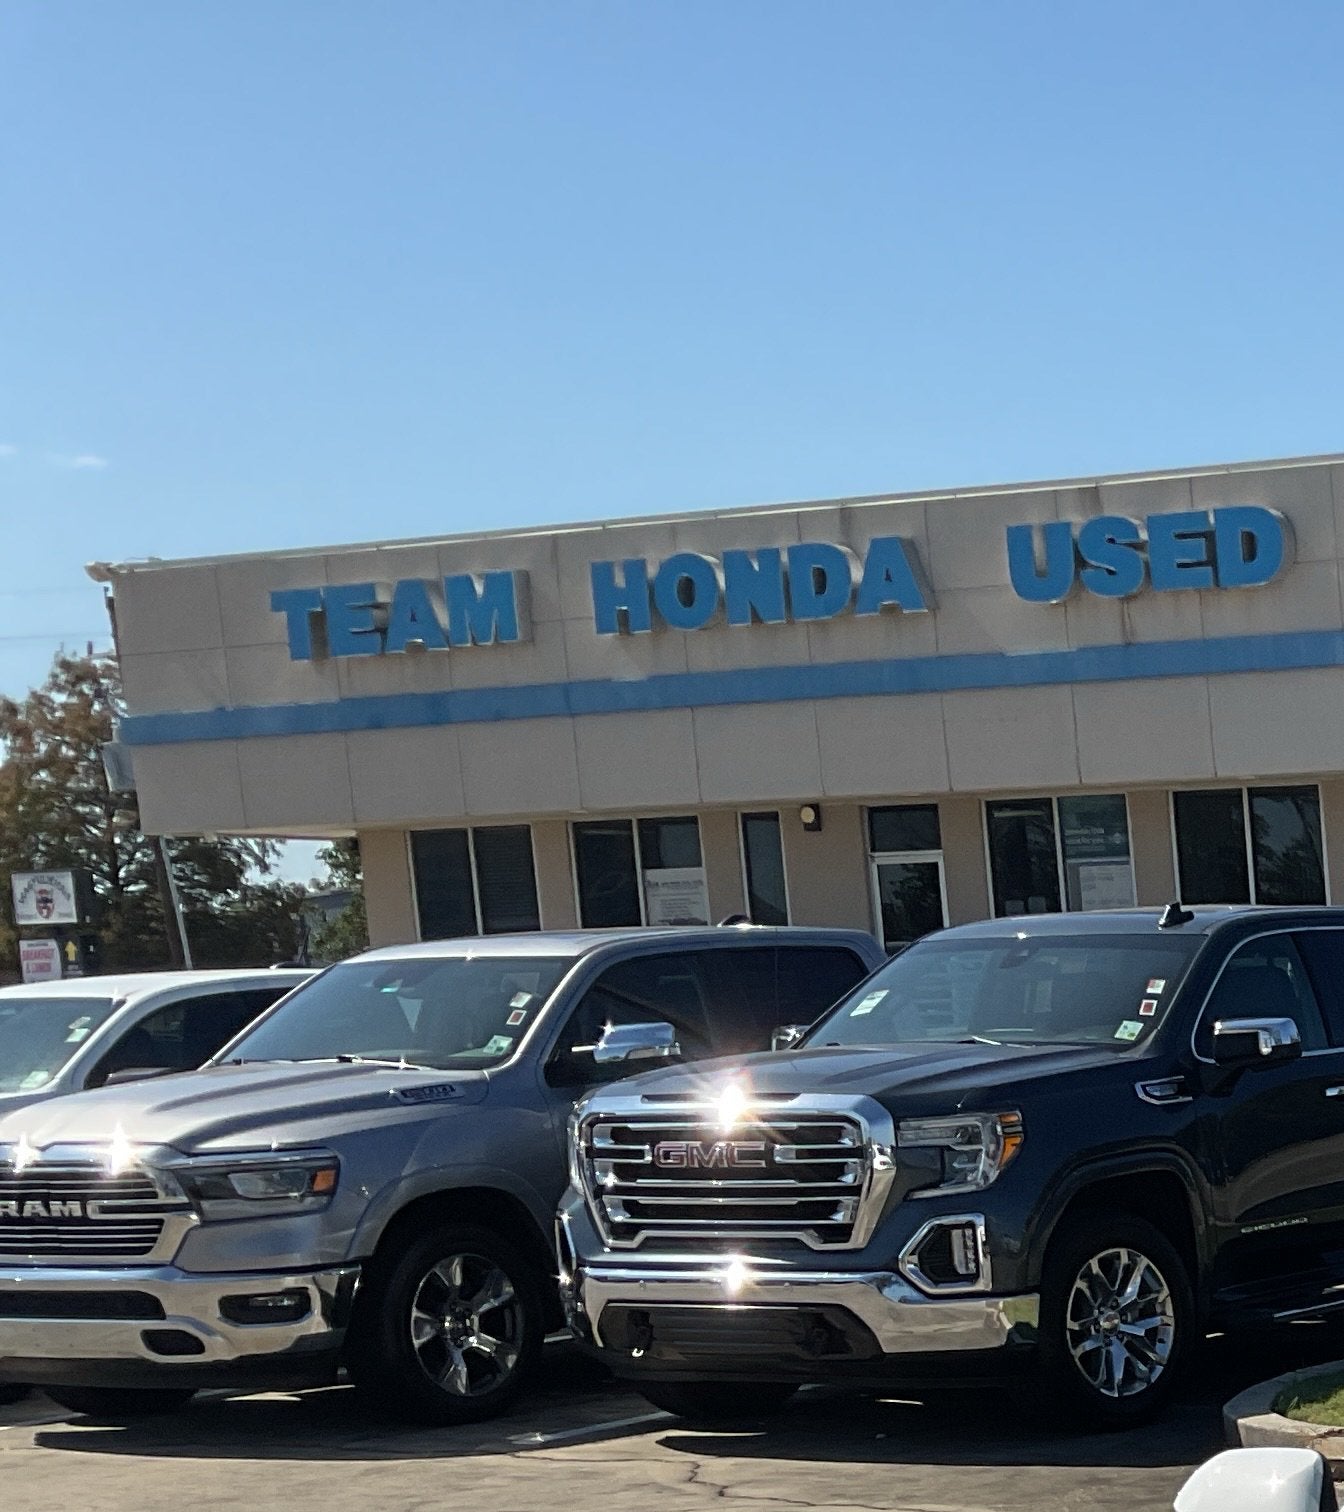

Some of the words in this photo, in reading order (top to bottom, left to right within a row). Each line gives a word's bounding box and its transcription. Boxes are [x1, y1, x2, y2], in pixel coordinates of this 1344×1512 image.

[271, 569, 520, 663] TEAM
[590, 535, 928, 636] HONDA
[1006, 505, 1285, 604] USED
[654, 1141, 767, 1168] GMC
[0, 1201, 82, 1217] RAM
